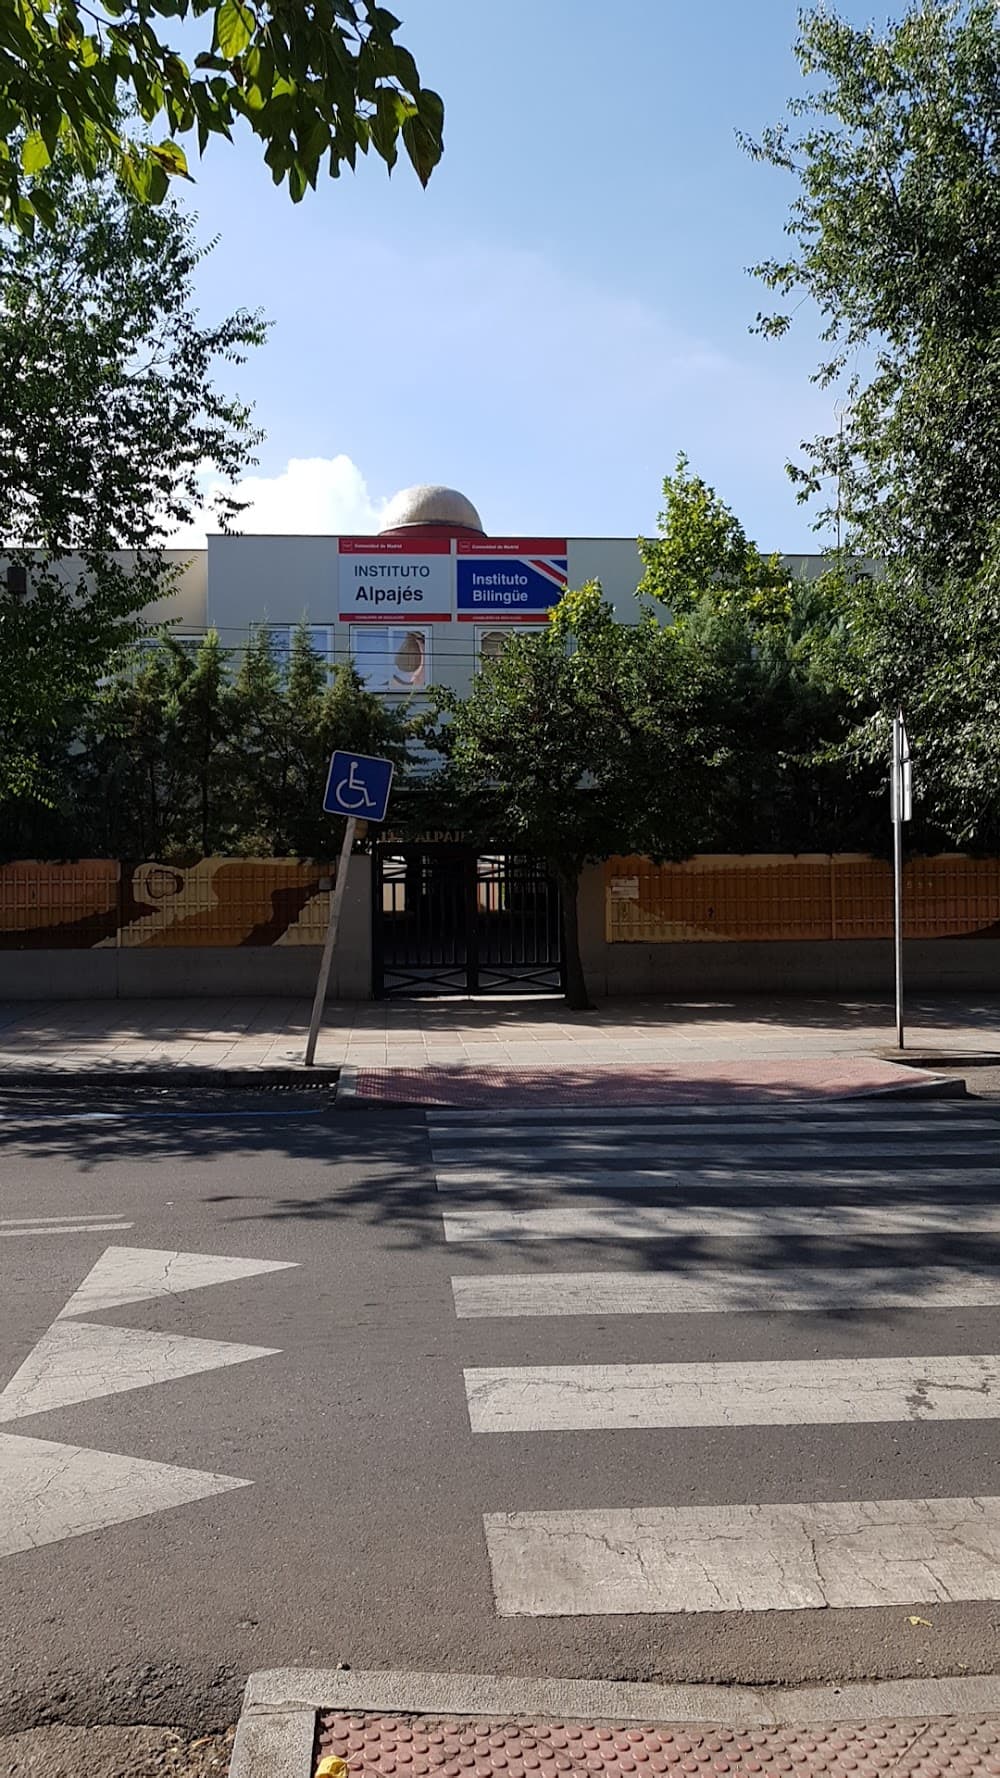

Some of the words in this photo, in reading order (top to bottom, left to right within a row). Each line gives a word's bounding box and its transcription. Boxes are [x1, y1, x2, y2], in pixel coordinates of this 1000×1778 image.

[354, 565, 430, 577] INSTITUTO
[472, 573, 528, 585] Instituto
[355, 585, 424, 605] Alpajés
[472, 590, 529, 604] Bilingüe
